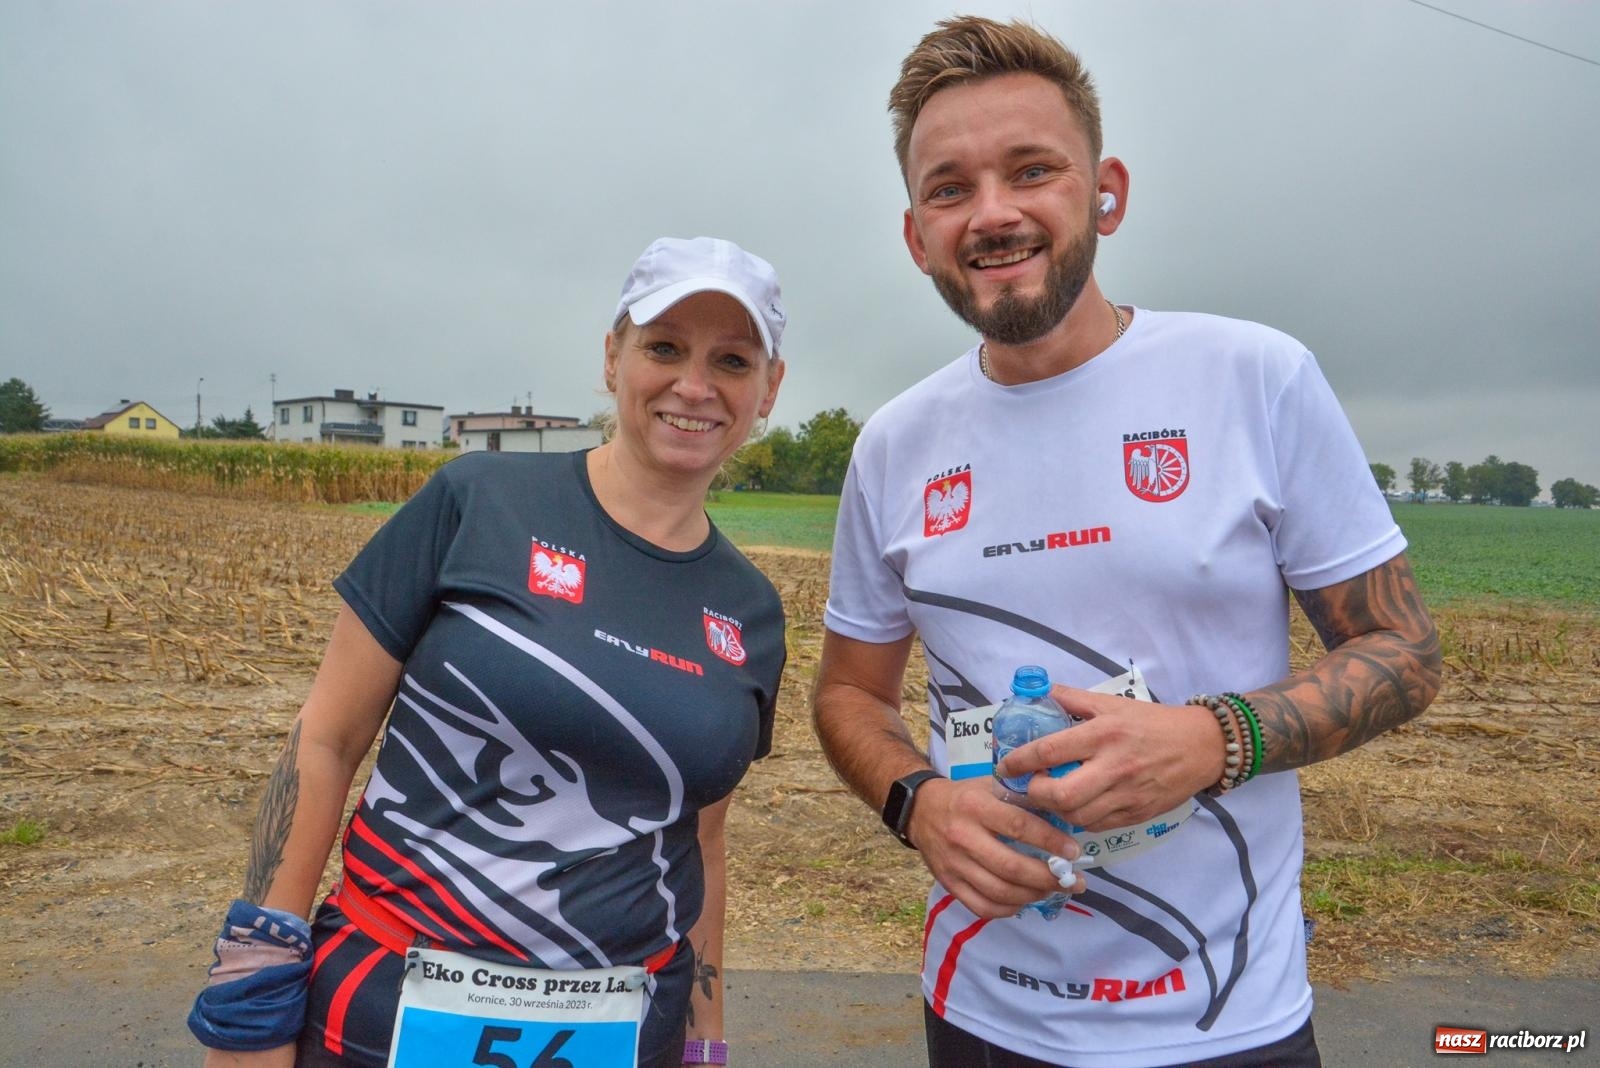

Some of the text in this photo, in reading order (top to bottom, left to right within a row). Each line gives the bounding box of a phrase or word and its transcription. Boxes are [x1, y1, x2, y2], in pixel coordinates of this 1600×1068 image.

[1123, 428, 1186, 443] RACIBÓRZ
[926, 463, 971, 485] POLSKA
[531, 535, 586, 562] POLSKA
[953, 721, 980, 738] Eko
[423, 961, 633, 995] Eko Cross przez La
[467, 992, 507, 1007] Kornice,
[509, 997, 522, 1007] 30
[523, 999, 564, 1009] września
[565, 1000, 586, 1010] 2023
